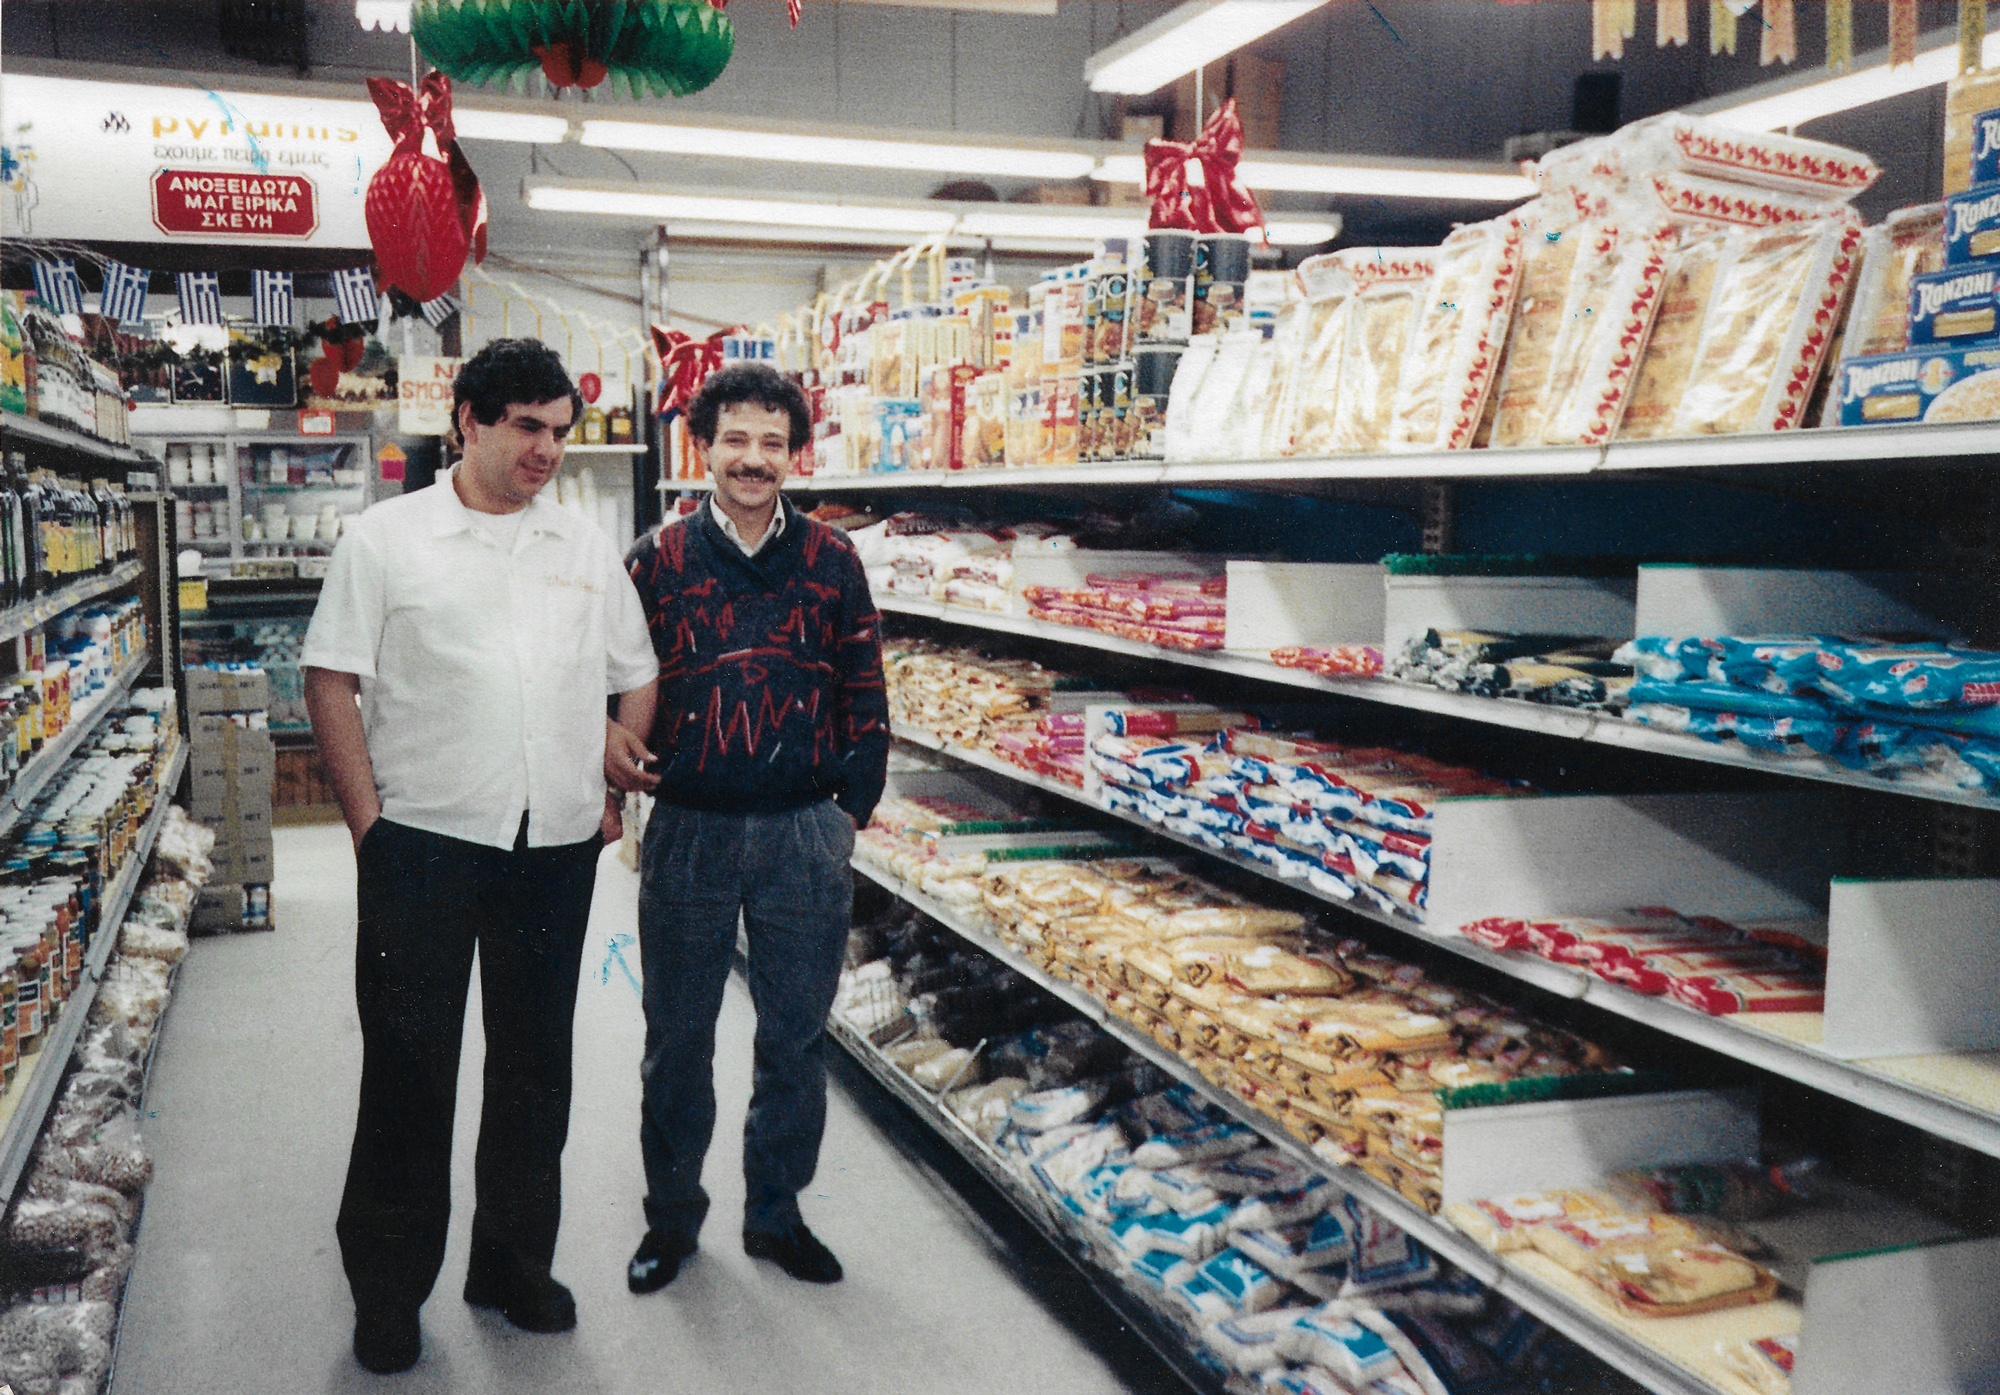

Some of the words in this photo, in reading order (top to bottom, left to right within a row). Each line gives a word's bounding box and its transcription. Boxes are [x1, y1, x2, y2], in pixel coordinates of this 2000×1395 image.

[169, 176, 302, 196] ΑΝΟΞΕΙΔΩΤΑ
[185, 194, 298, 213] ΜΑΓΕΙΡΙΚΑ
[200, 212, 273, 229] ΣΚΕΥΗ
[1913, 271, 1994, 322] RONZONI
[434, 362, 461, 380] N
[1843, 358, 1919, 405] RONZONI
